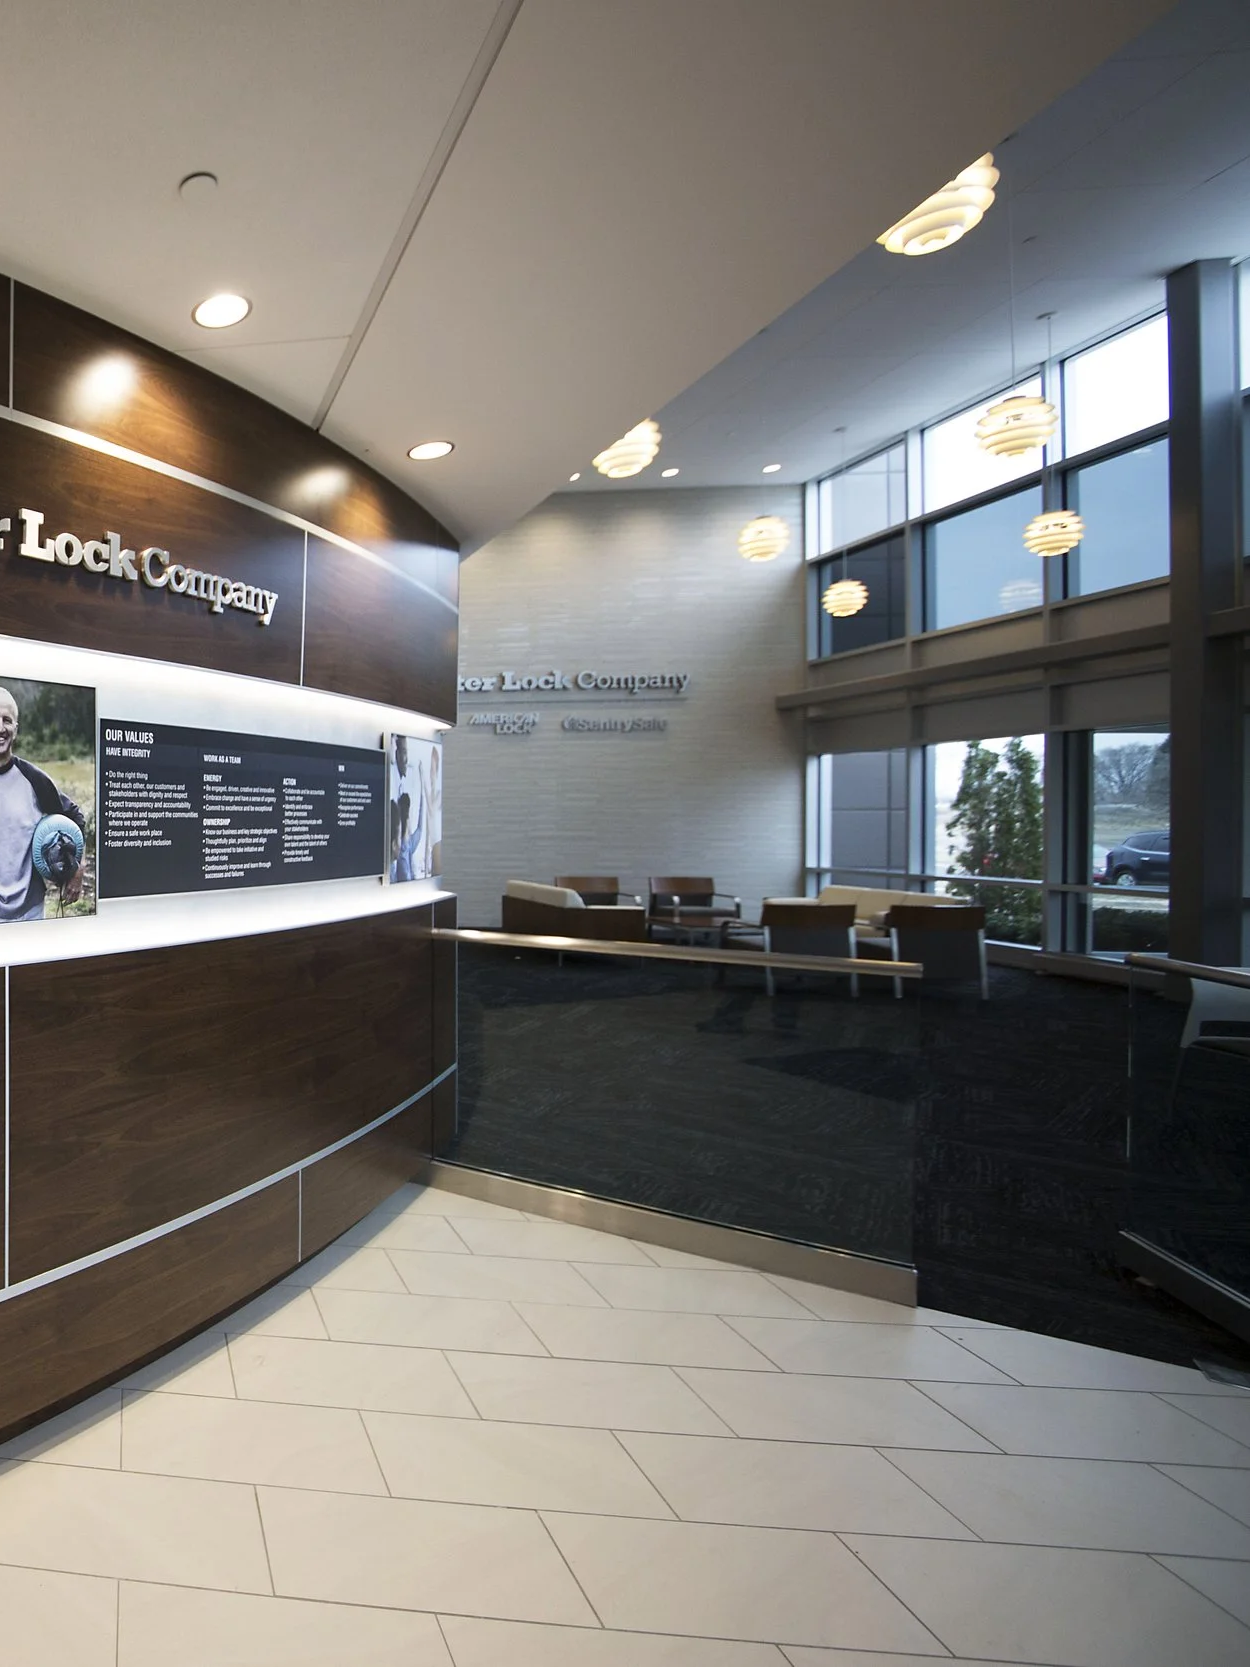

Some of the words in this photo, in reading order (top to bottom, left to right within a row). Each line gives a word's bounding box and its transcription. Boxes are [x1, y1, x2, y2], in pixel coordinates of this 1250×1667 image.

[18, 508, 138, 581] Lock
[141, 545, 279, 626] Company
[457, 674, 497, 692] ter
[501, 670, 573, 692] Lock
[577, 670, 690, 693] Company
[469, 712, 540, 725] AMERICAN
[495, 723, 532, 735] LOCK
[105, 729, 123, 741] OUR
[125, 731, 154, 744] VALUES
[106, 747, 121, 756] HAVE
[122, 748, 151, 758] INTEGRITY
[218, 755, 225, 763] AS
[229, 756, 241, 764] TEAM
[109, 770, 117, 778] Do
[125, 772, 136, 780] right
[136, 772, 148, 780] thing
[203, 774, 222, 782] ENERGY
[149, 791, 164, 799] dignity
[108, 800, 125, 808] Expect
[125, 801, 154, 809] transparency
[203, 818, 231, 826] OWNERSHIP
[108, 829, 125, 837] Ensure
